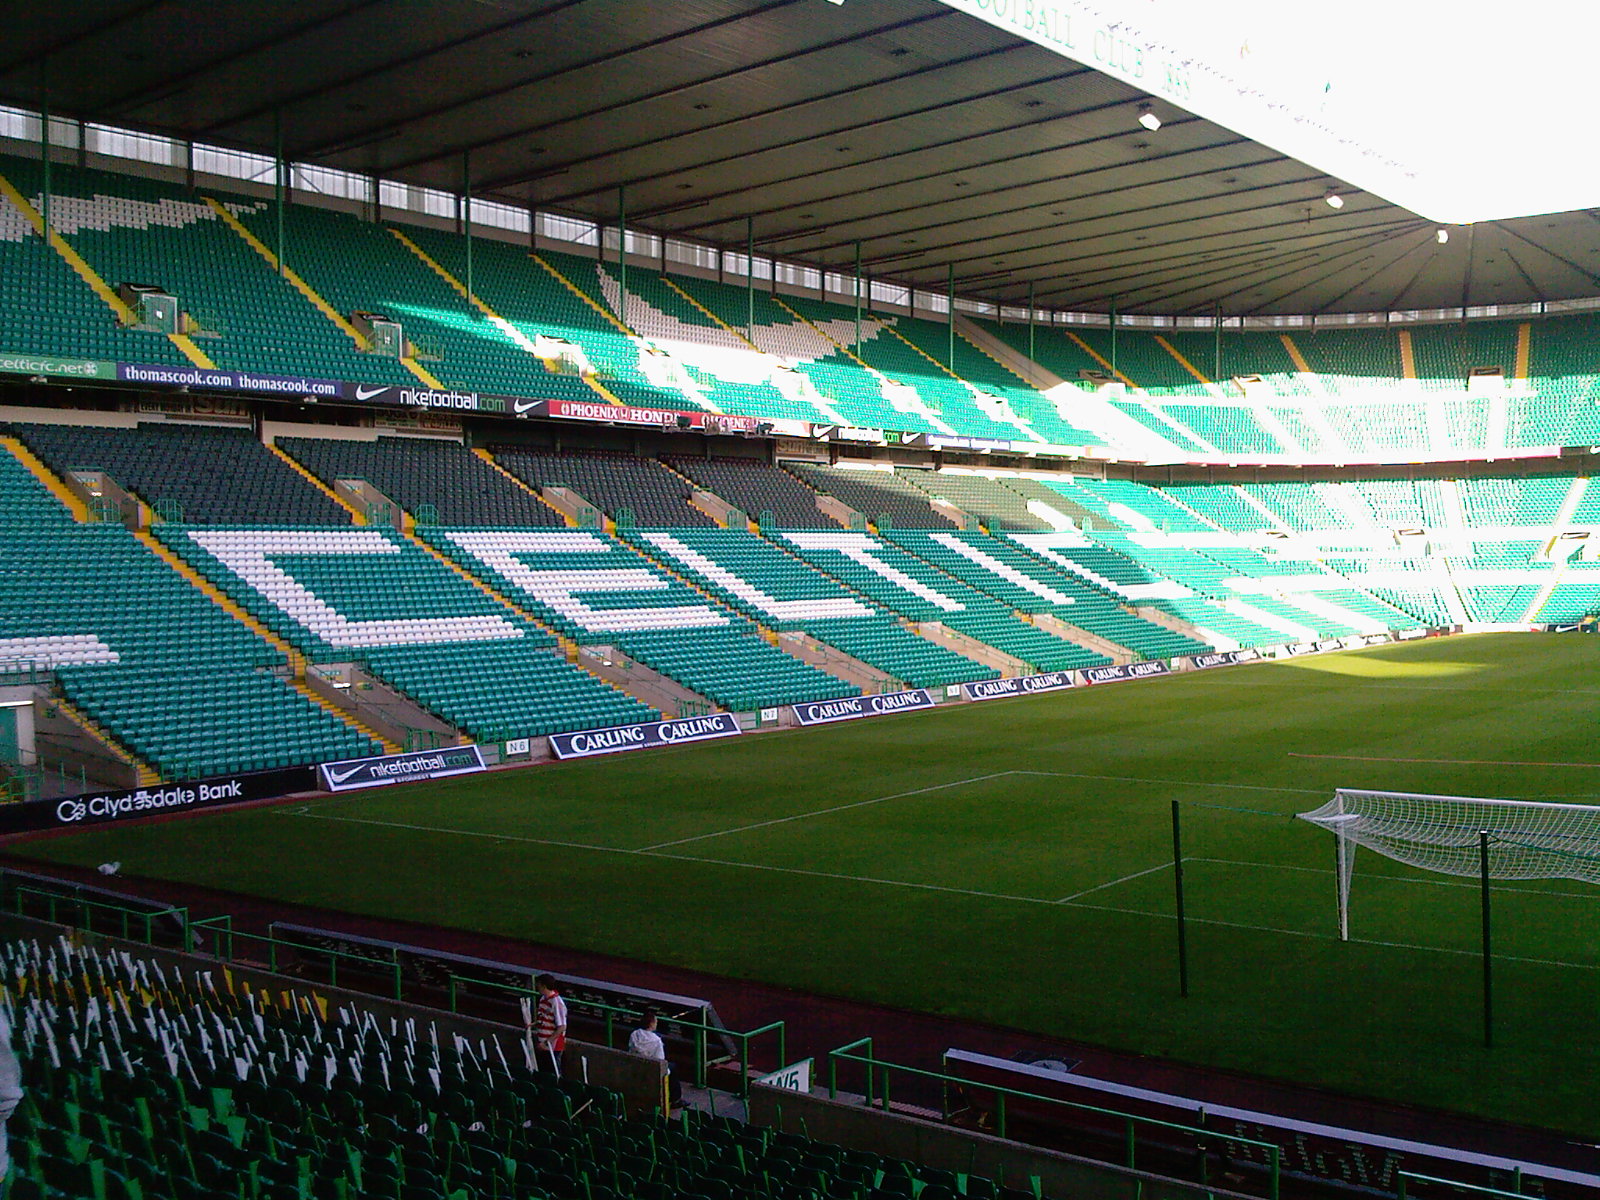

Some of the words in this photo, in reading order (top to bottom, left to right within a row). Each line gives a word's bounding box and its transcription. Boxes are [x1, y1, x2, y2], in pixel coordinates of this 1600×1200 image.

[963, 0, 1075, 49] OTBALL
[1094, 29, 1144, 78] CLUB
[125, 366, 232, 387] thomascook.com
[239, 375, 336, 395] thomascook.com
[400, 387, 506, 411] nikefootball.com
[570, 403, 619, 419] PHOENIX
[1088, 667, 1124, 682] CARLING
[1128, 662, 1162, 678] CARLING
[974, 680, 1017, 697] CARLING
[1022, 674, 1062, 692] CARLING
[808, 700, 862, 720] CARLING
[871, 692, 921, 712] CARLING
[570, 727, 645, 753] CARLING
[657, 717, 725, 741] CARLING
[369, 754, 472, 778] nikefootball.com
[89, 787, 195, 817] Clydesdale
[199, 780, 242, 801] Bank
